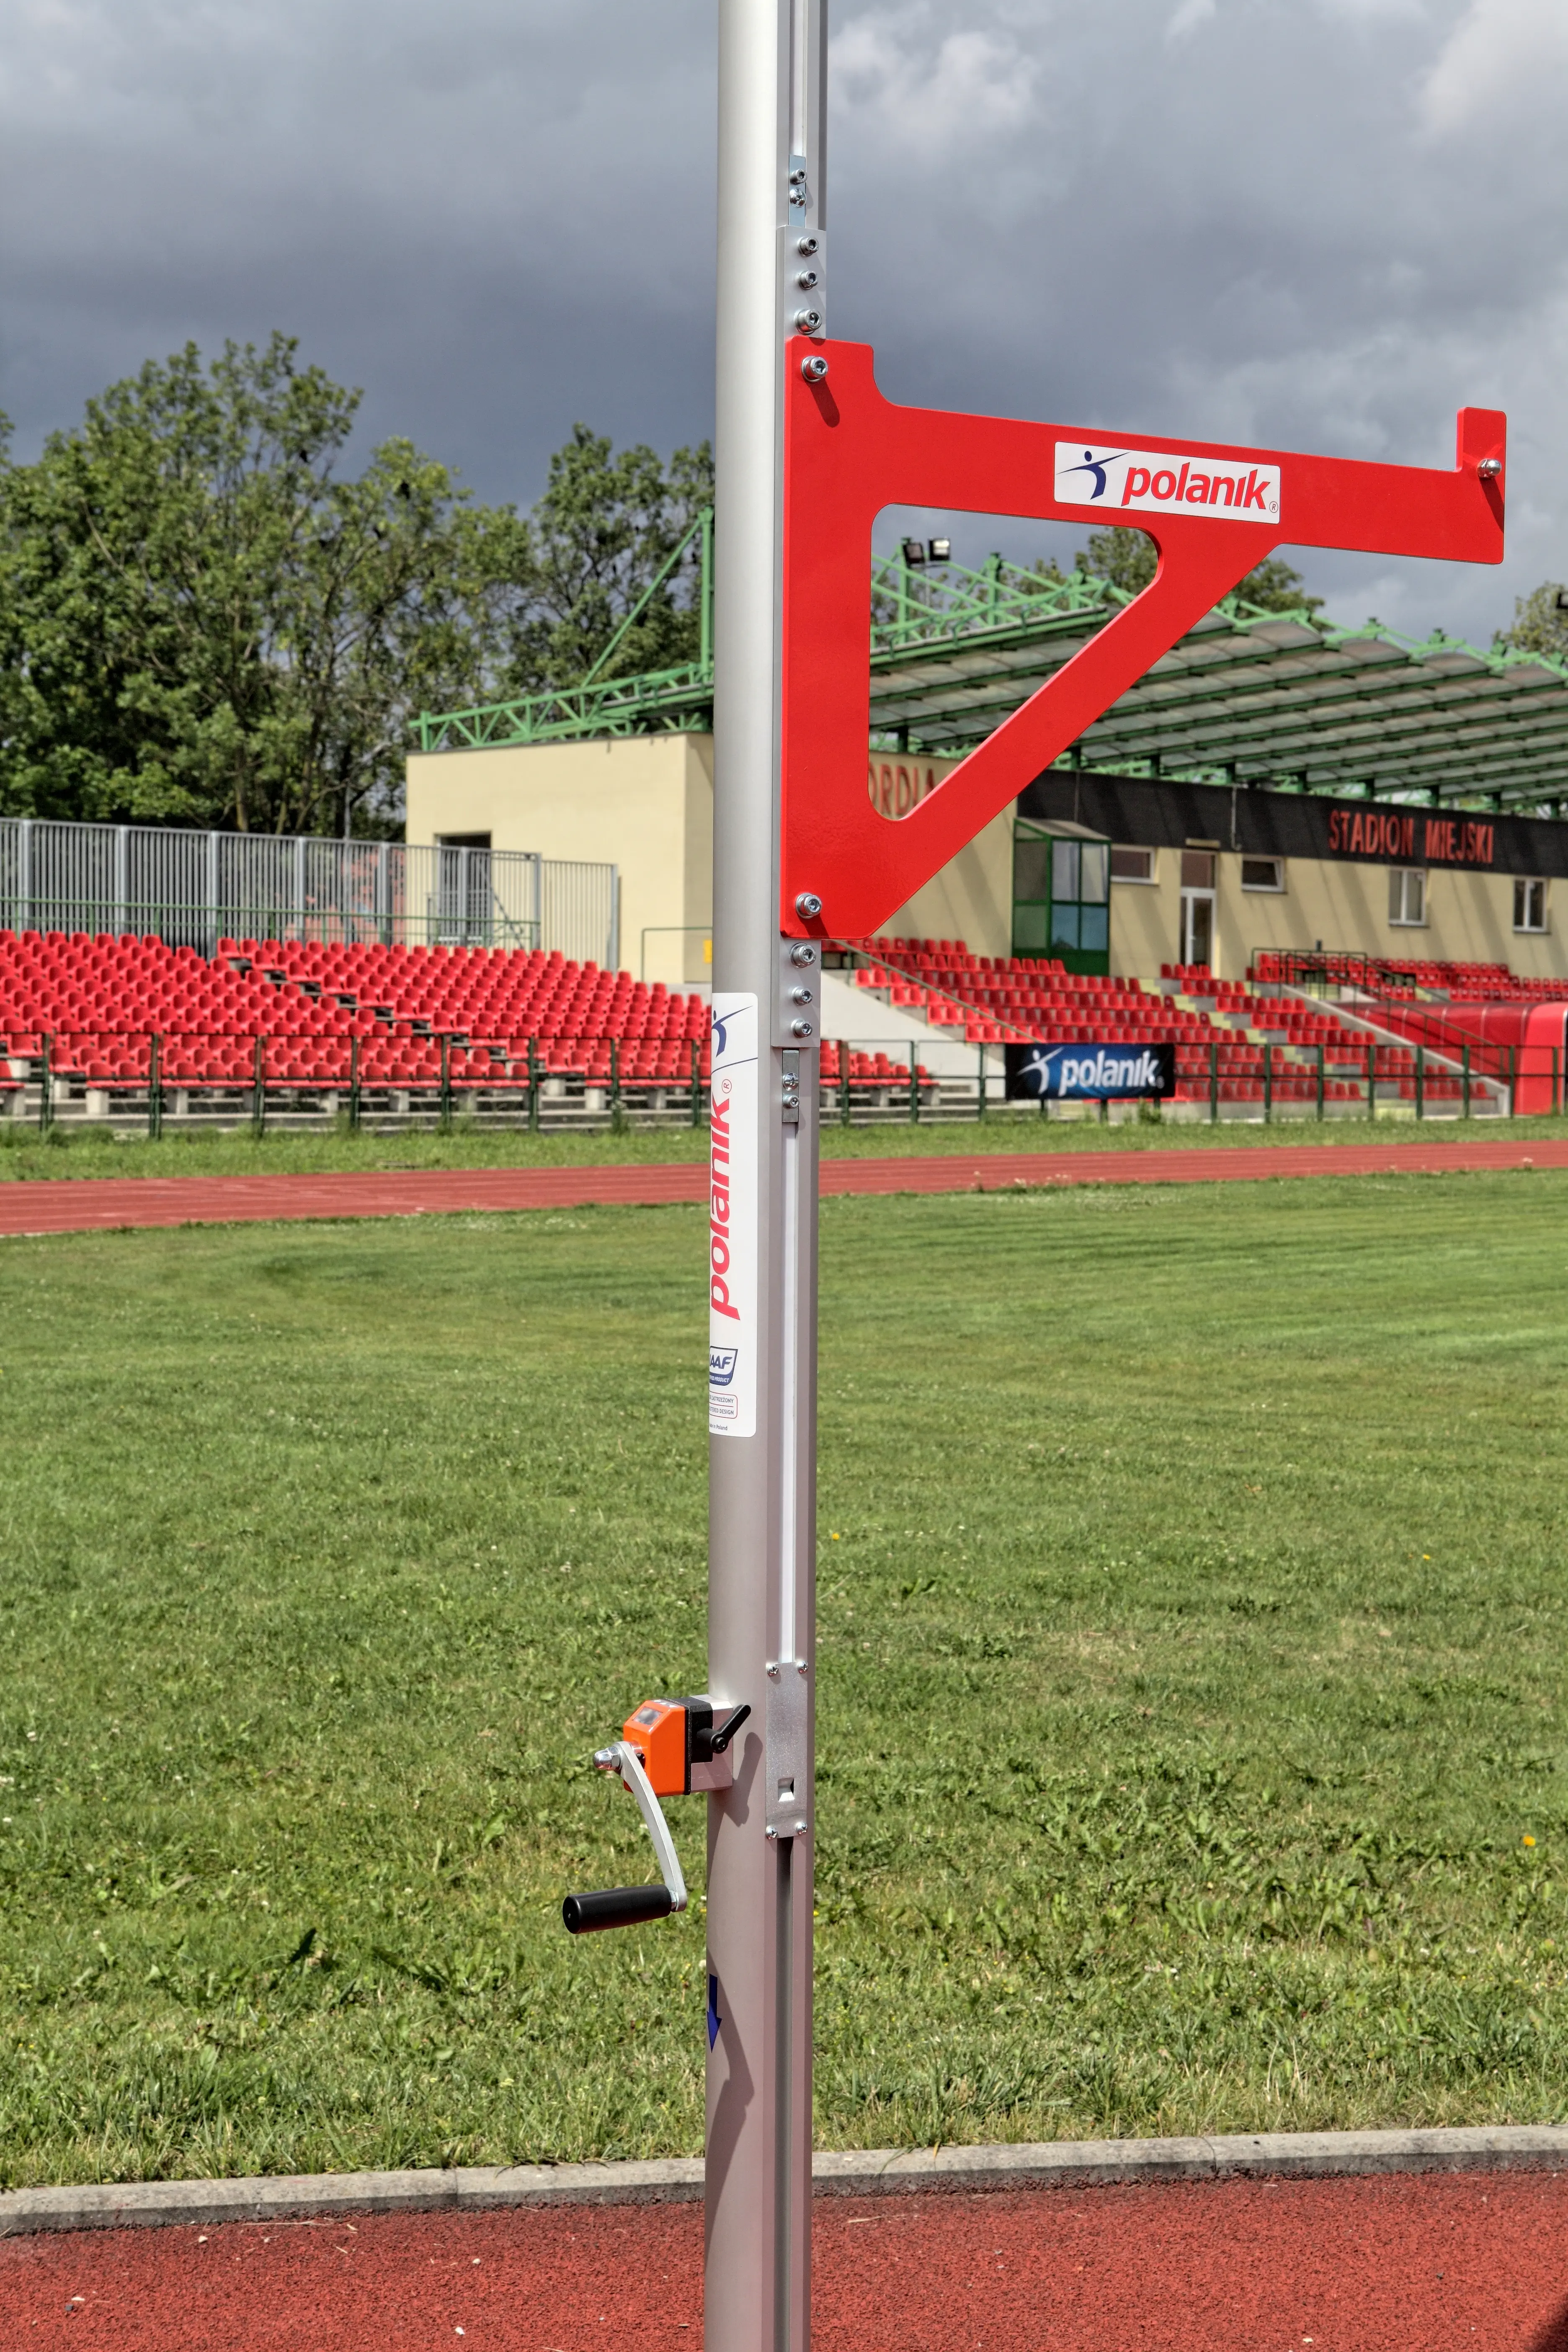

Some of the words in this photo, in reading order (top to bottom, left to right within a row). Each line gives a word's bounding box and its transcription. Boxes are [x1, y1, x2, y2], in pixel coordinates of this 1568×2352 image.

[1121, 462, 1271, 510] polanik
[1328, 809, 1415, 857] STADION
[1425, 818, 1495, 864] MIEJSKI
[1058, 1050, 1160, 1097] polanik
[710, 1091, 741, 1321] polanik
